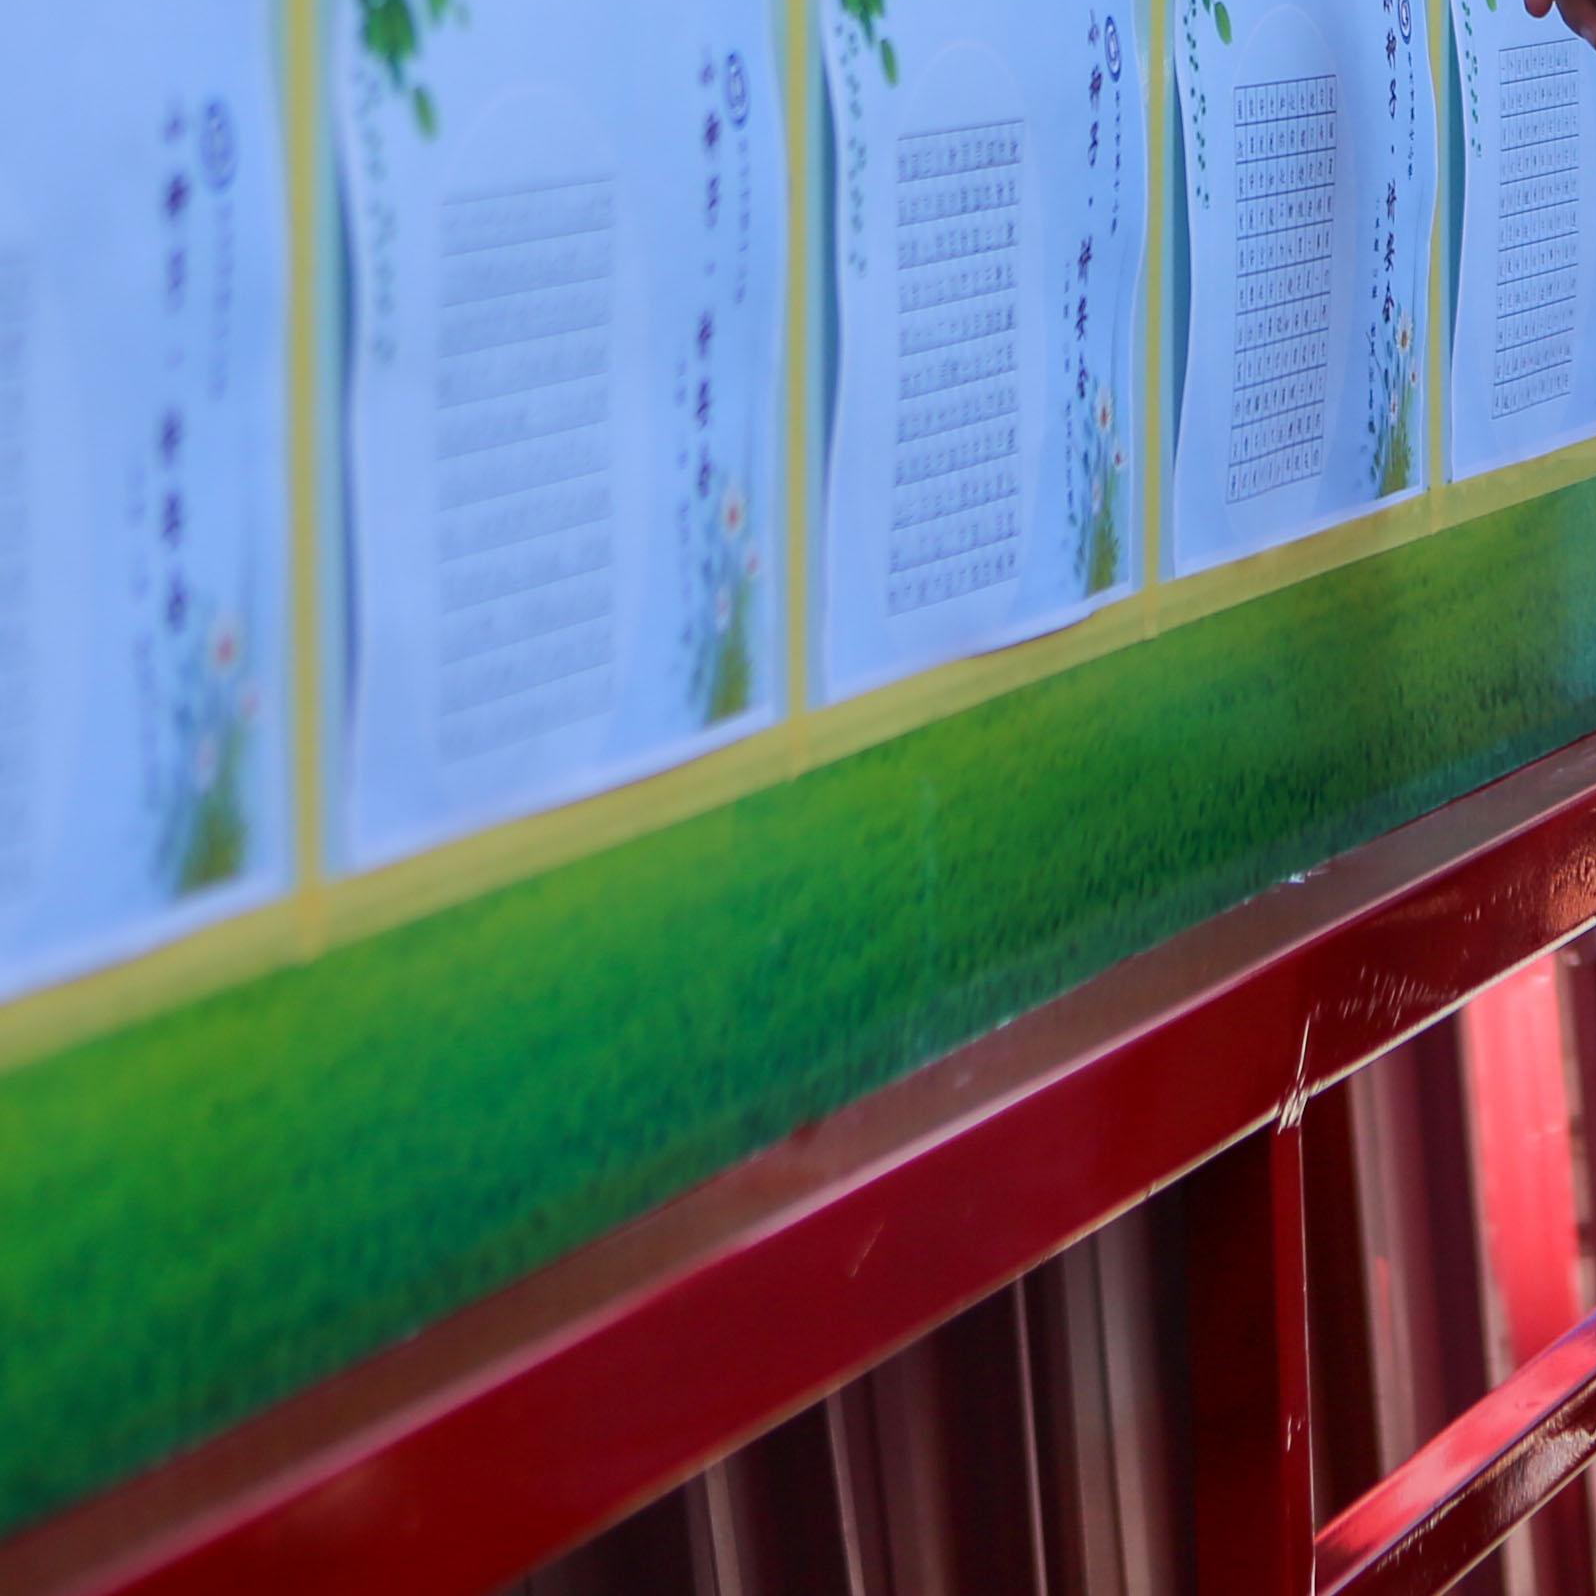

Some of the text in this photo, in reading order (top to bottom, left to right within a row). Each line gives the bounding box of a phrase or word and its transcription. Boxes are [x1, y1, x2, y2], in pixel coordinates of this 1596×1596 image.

[1075, 8, 1103, 400] 小种子·讲安全
